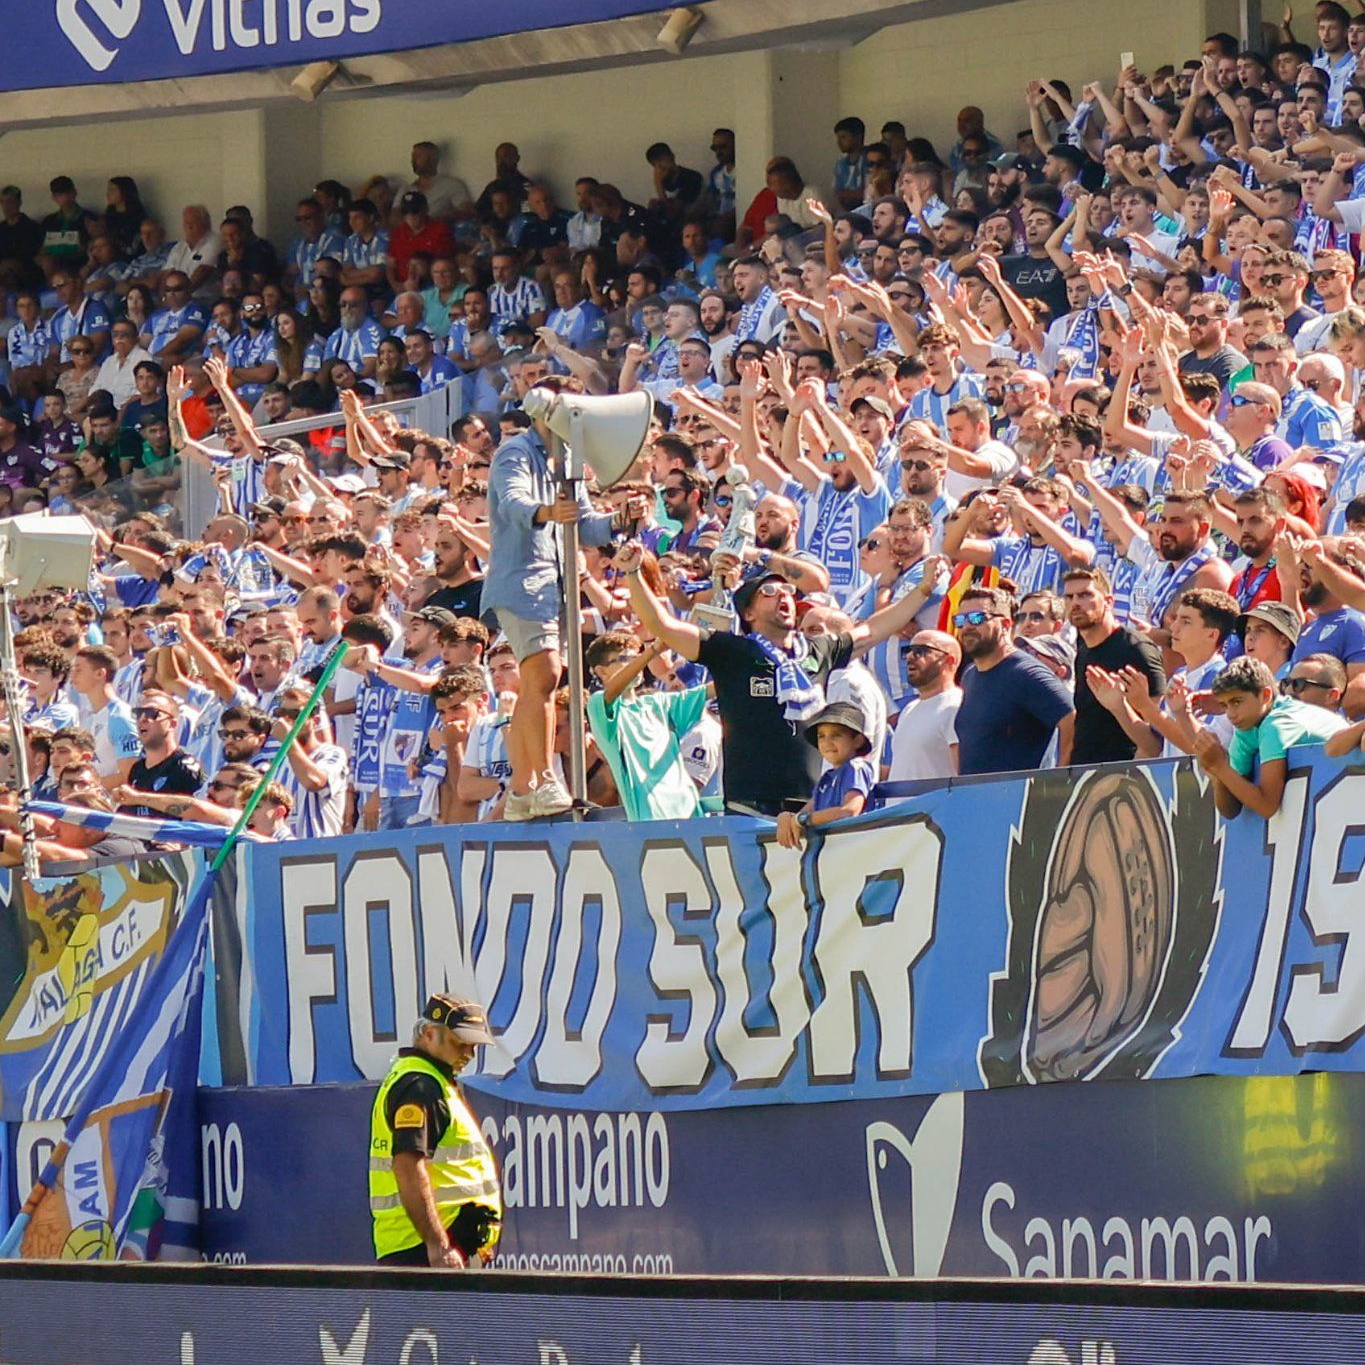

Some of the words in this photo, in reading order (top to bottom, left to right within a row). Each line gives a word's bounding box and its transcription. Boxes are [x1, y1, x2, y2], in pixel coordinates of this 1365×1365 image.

[1016, 269, 1057, 285] EA7
[281, 839, 623, 1085] FONDO
[635, 813, 944, 1097] SUR
[982, 1181, 1271, 1282] Sanamar
